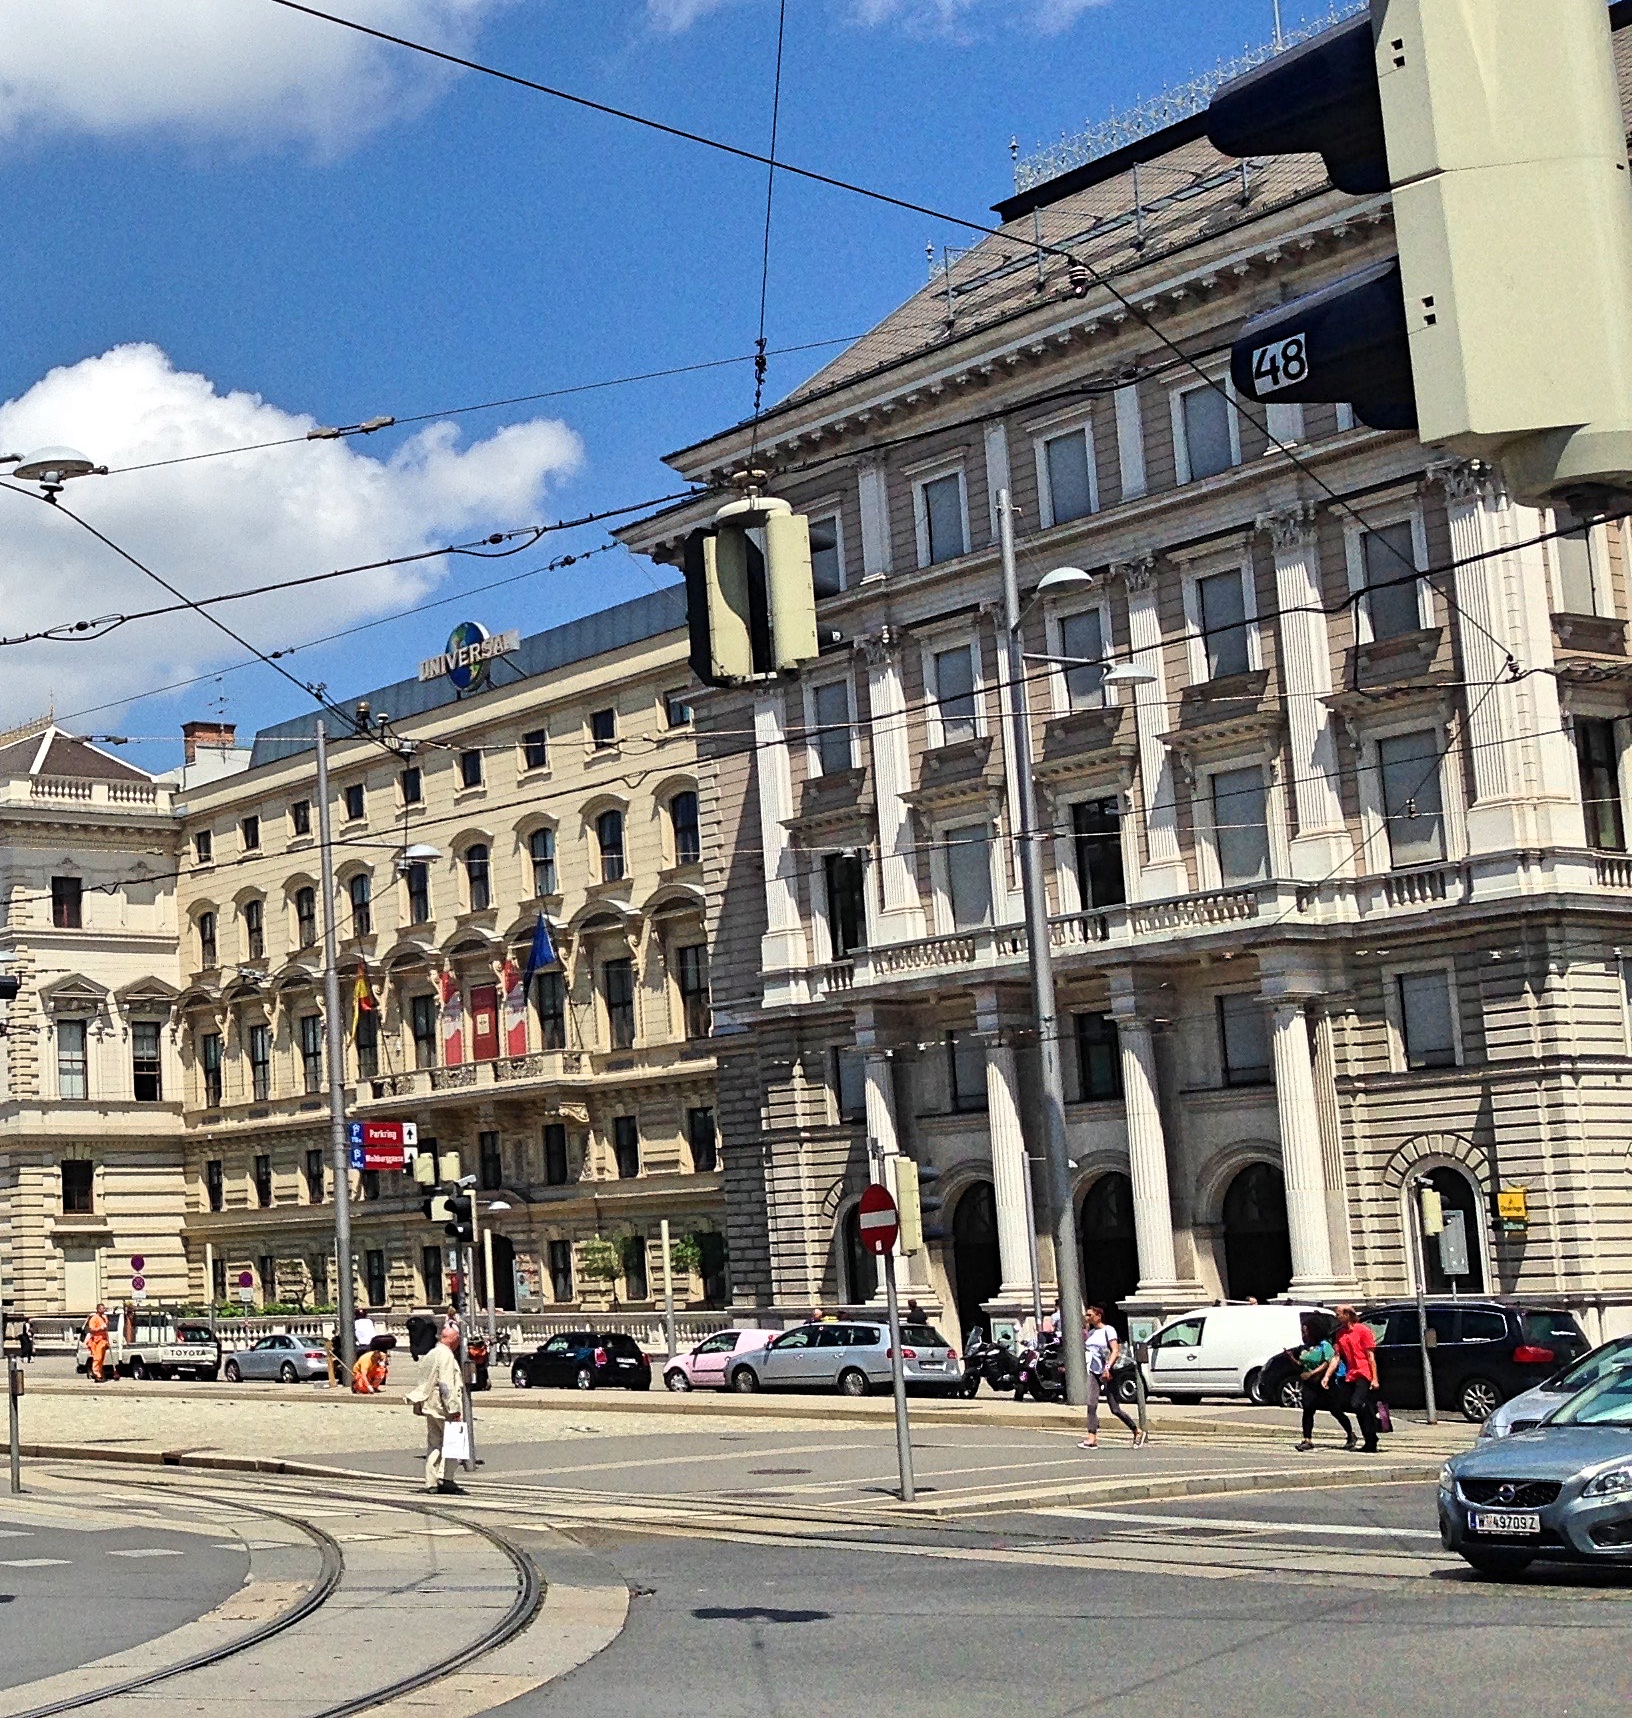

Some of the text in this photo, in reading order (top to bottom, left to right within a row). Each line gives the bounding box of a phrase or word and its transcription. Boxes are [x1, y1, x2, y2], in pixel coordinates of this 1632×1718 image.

[1254, 338, 1306, 386] 48
[369, 1129, 398, 1141] Parkring
[169, 1349, 207, 1357] TOYOTA
[1493, 1515, 1527, 1530] 49709
[1529, 1517, 1537, 1530] Z
